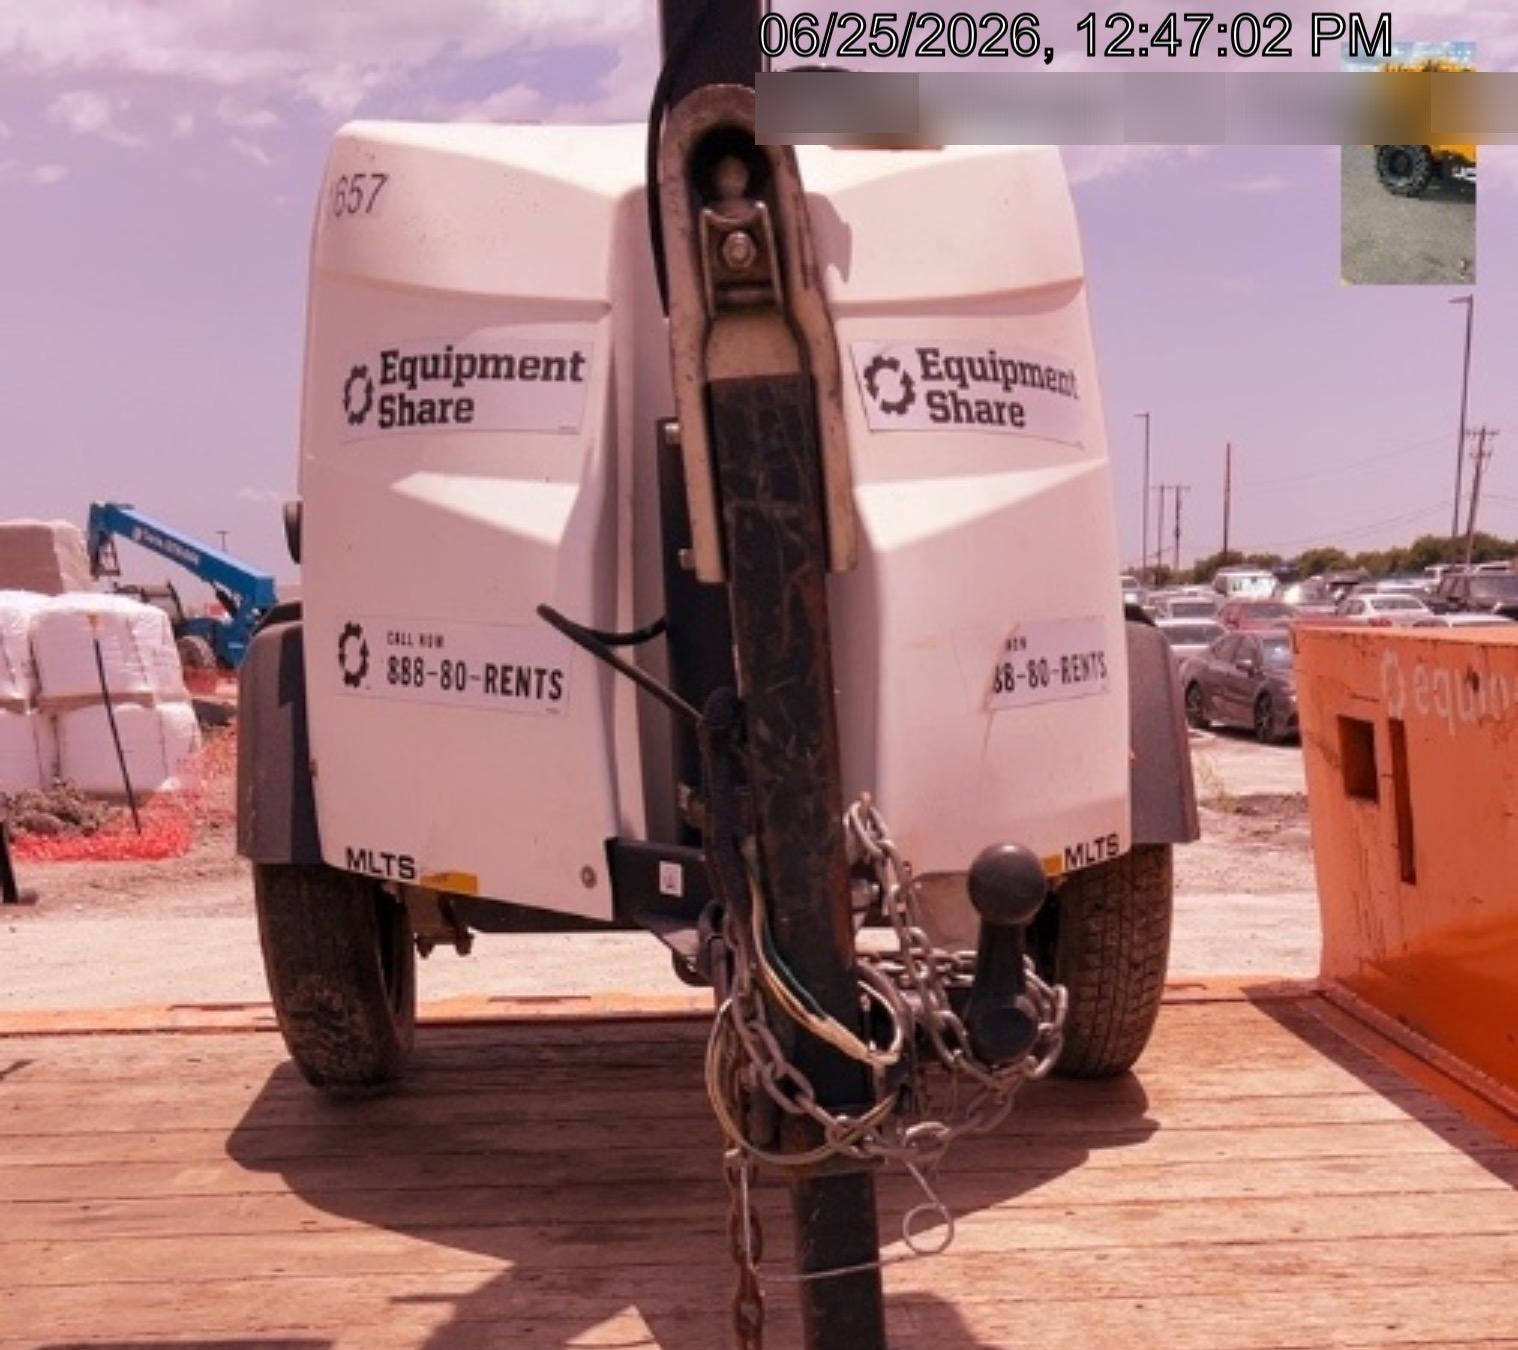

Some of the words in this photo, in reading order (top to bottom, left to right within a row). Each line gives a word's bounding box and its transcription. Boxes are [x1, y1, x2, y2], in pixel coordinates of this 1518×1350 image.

[380, 345, 586, 390] Equipment
[916, 347, 1080, 399] Equipment
[378, 391, 475, 429] Share
[925, 389, 1027, 427] Share
[386, 654, 564, 701] 888-80-RENTS
[345, 846, 416, 880] MLTS
[1064, 832, 1120, 870] MLTS
